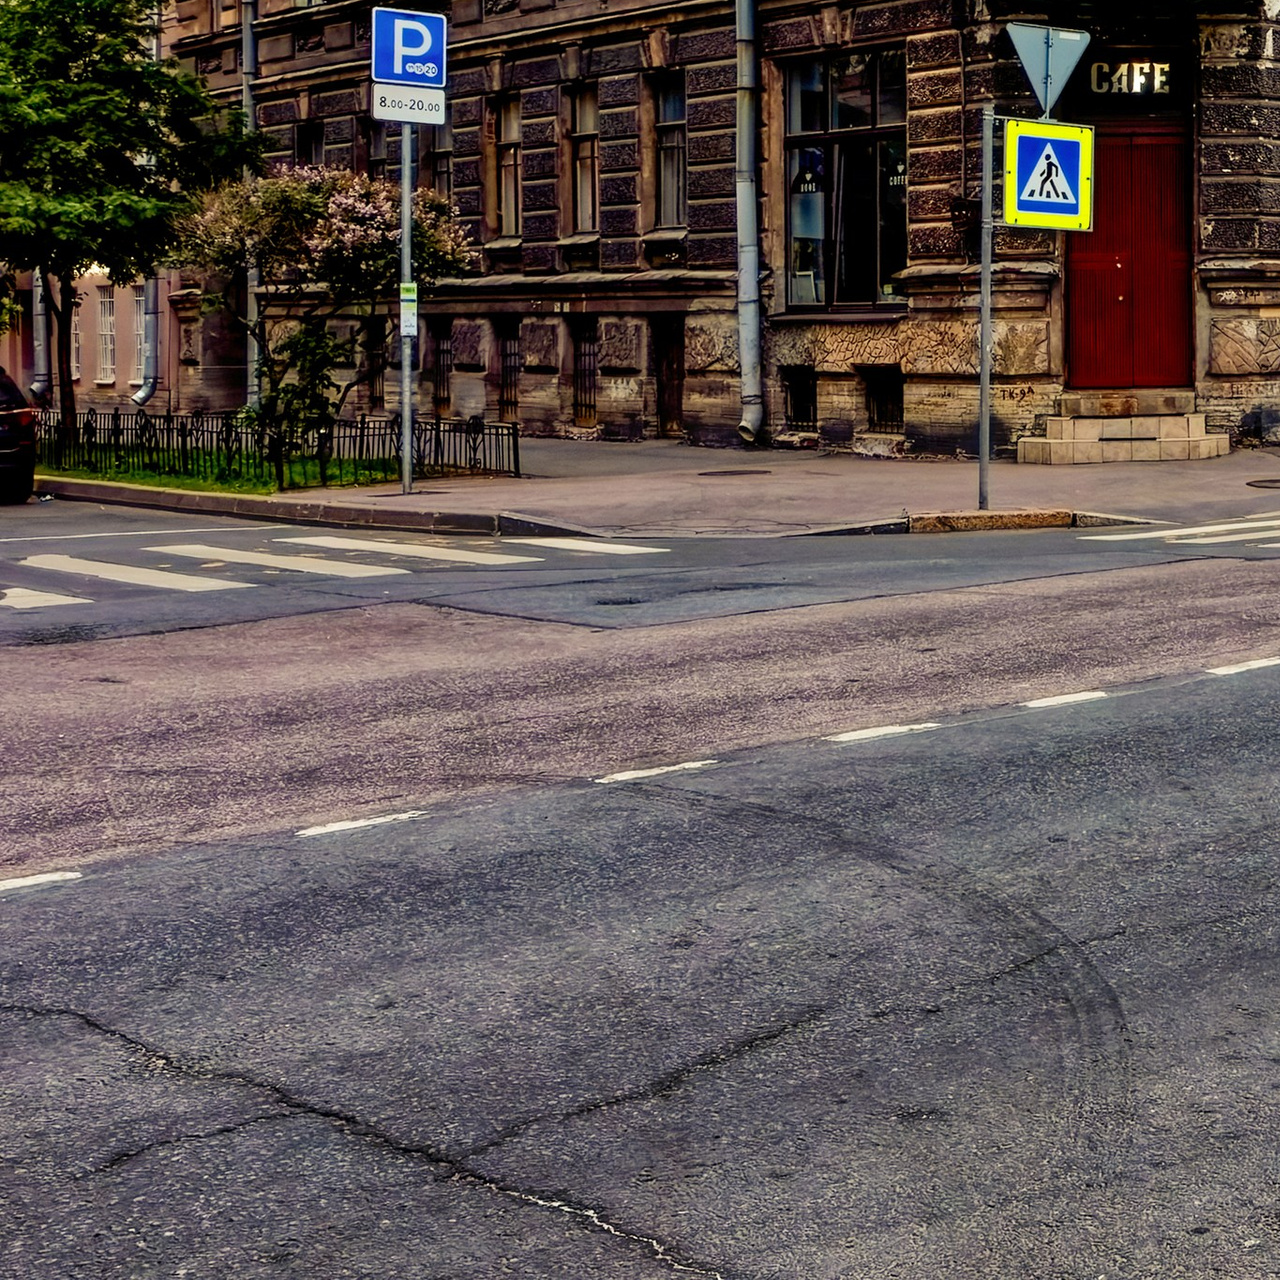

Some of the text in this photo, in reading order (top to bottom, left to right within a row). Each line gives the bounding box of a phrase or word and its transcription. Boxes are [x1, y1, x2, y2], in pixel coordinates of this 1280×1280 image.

[393, 19, 432, 74] P
[425, 66, 437, 74] 20
[1091, 62, 1170, 93] CAFE
[379, 96, 440, 112] 8.00-20.00
